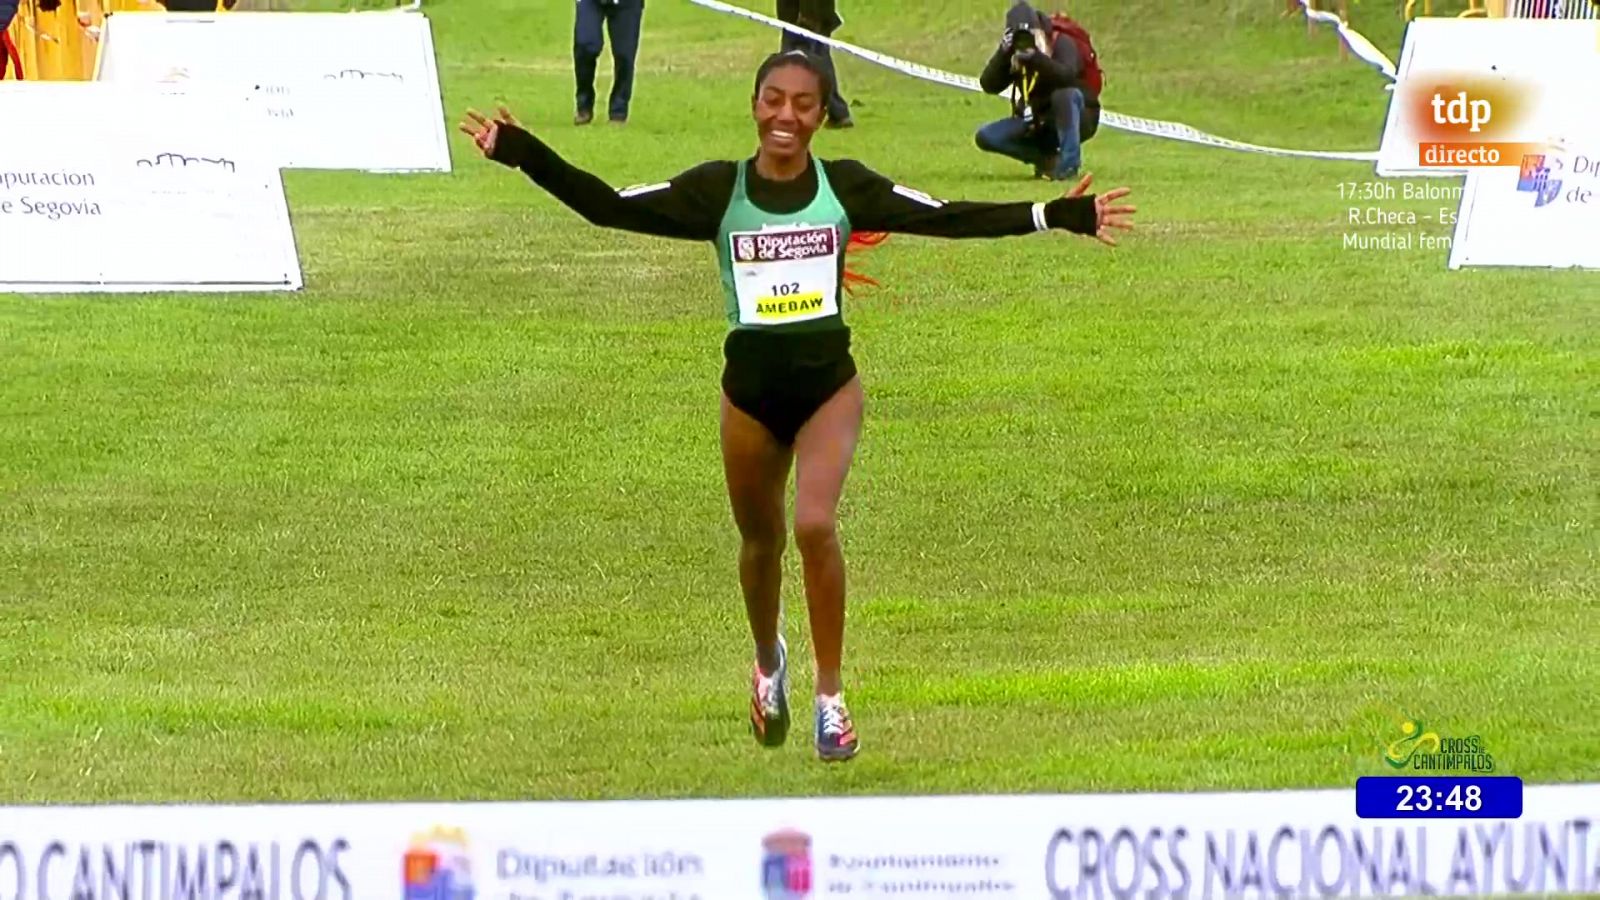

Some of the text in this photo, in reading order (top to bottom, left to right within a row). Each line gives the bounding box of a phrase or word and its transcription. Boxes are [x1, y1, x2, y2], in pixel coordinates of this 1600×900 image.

[1566, 186, 1592, 203] de
[20, 196, 101, 220] Segovia
[757, 231, 828, 248] Diputación
[778, 244, 828, 260] Segovia
[771, 282, 800, 296] 102
[1045, 826, 1191, 899] CROSS
[1203, 824, 1438, 897] NACIONAL
